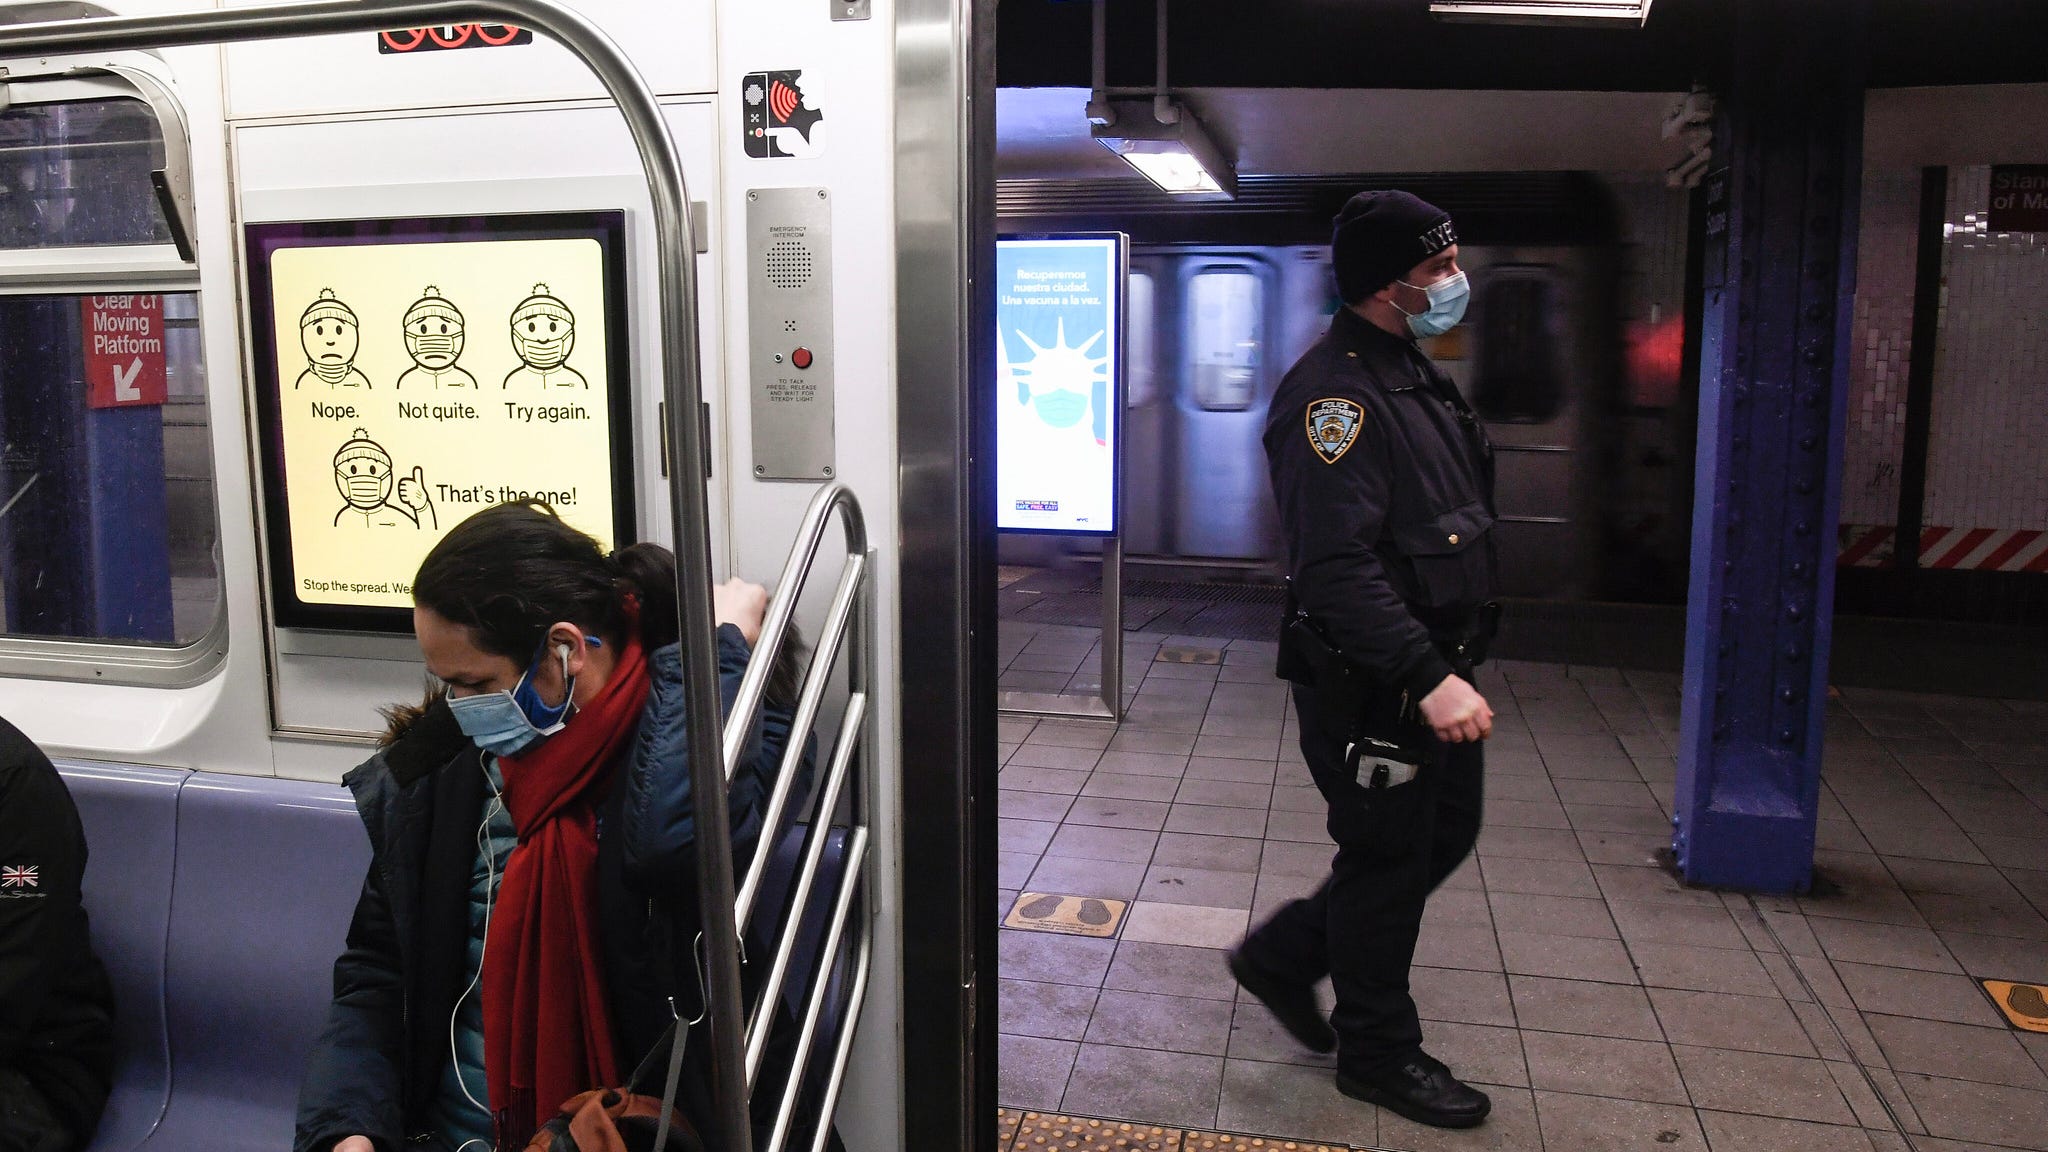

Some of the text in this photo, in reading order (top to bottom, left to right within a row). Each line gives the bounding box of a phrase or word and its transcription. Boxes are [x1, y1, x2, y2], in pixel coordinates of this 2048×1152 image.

[1995, 172, 2048, 189] Stan
[1993, 192, 2016, 209] of
[1017, 269, 1087, 282] Recuperemos
[1013, 281, 1091, 292] nuestra ciudad.
[92, 295, 135, 309] Clear
[1002, 295, 1101, 305] Una vacuna a la vez.
[93, 311, 150, 336] Moving
[94, 334, 161, 355] Platform
[311, 401, 360, 421] Nope.
[398, 402, 480, 422] Not quite.
[505, 402, 591, 423] Try again.
[1310, 407, 1359, 419] DEPARTMENT
[1321, 401, 1350, 410] POLICE
[1309, 425, 1326, 452] CITY OF
[1333, 422, 1360, 455] NEW YORK
[436, 484, 577, 505] That's the one!
[303, 578, 411, 595] Stop the spread. We
